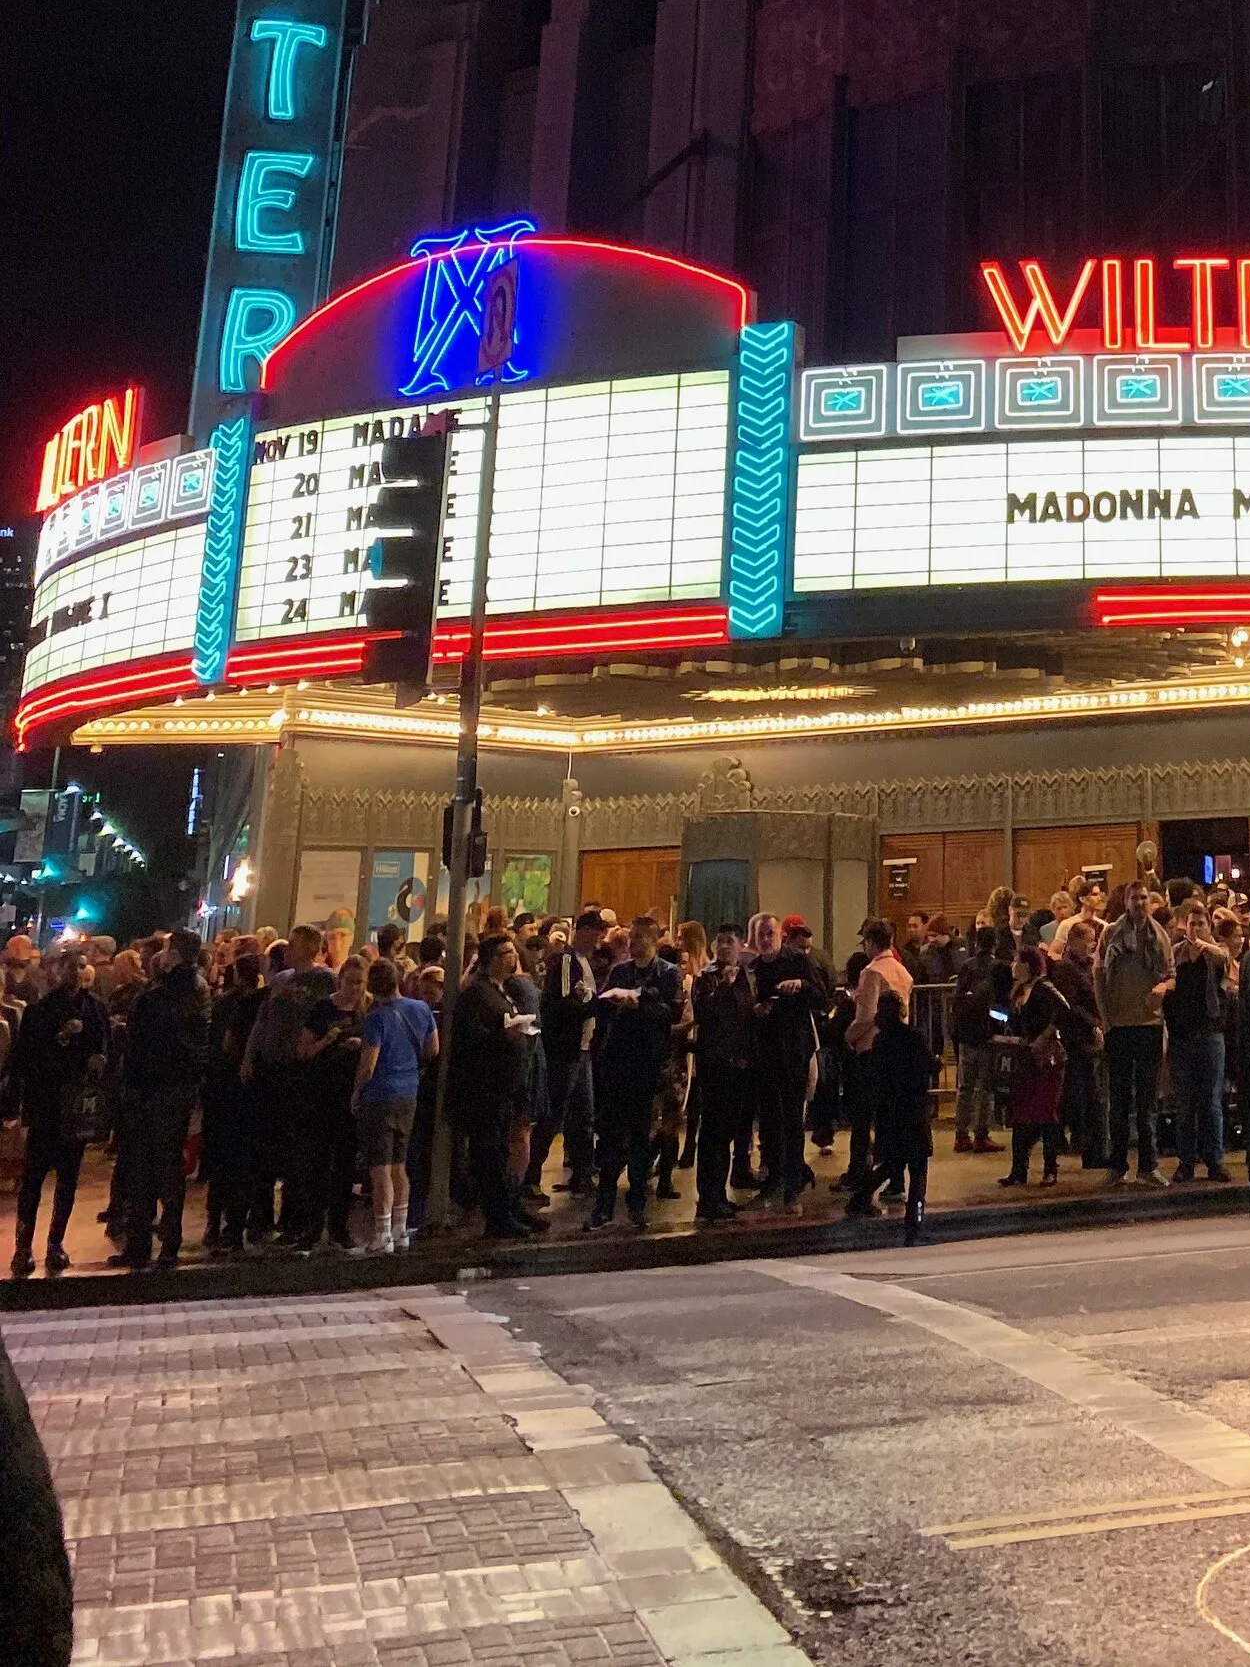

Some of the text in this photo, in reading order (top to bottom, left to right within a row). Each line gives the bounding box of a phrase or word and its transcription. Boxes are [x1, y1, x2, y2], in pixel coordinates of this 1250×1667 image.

[254, 434, 291, 464] NOV
[300, 430, 319, 456] 19
[292, 472, 319, 498] 20
[1006, 487, 1200, 525] MADONNA
[290, 512, 312, 540] 21
[284, 554, 312, 582] 23
[280, 597, 307, 625] 24
